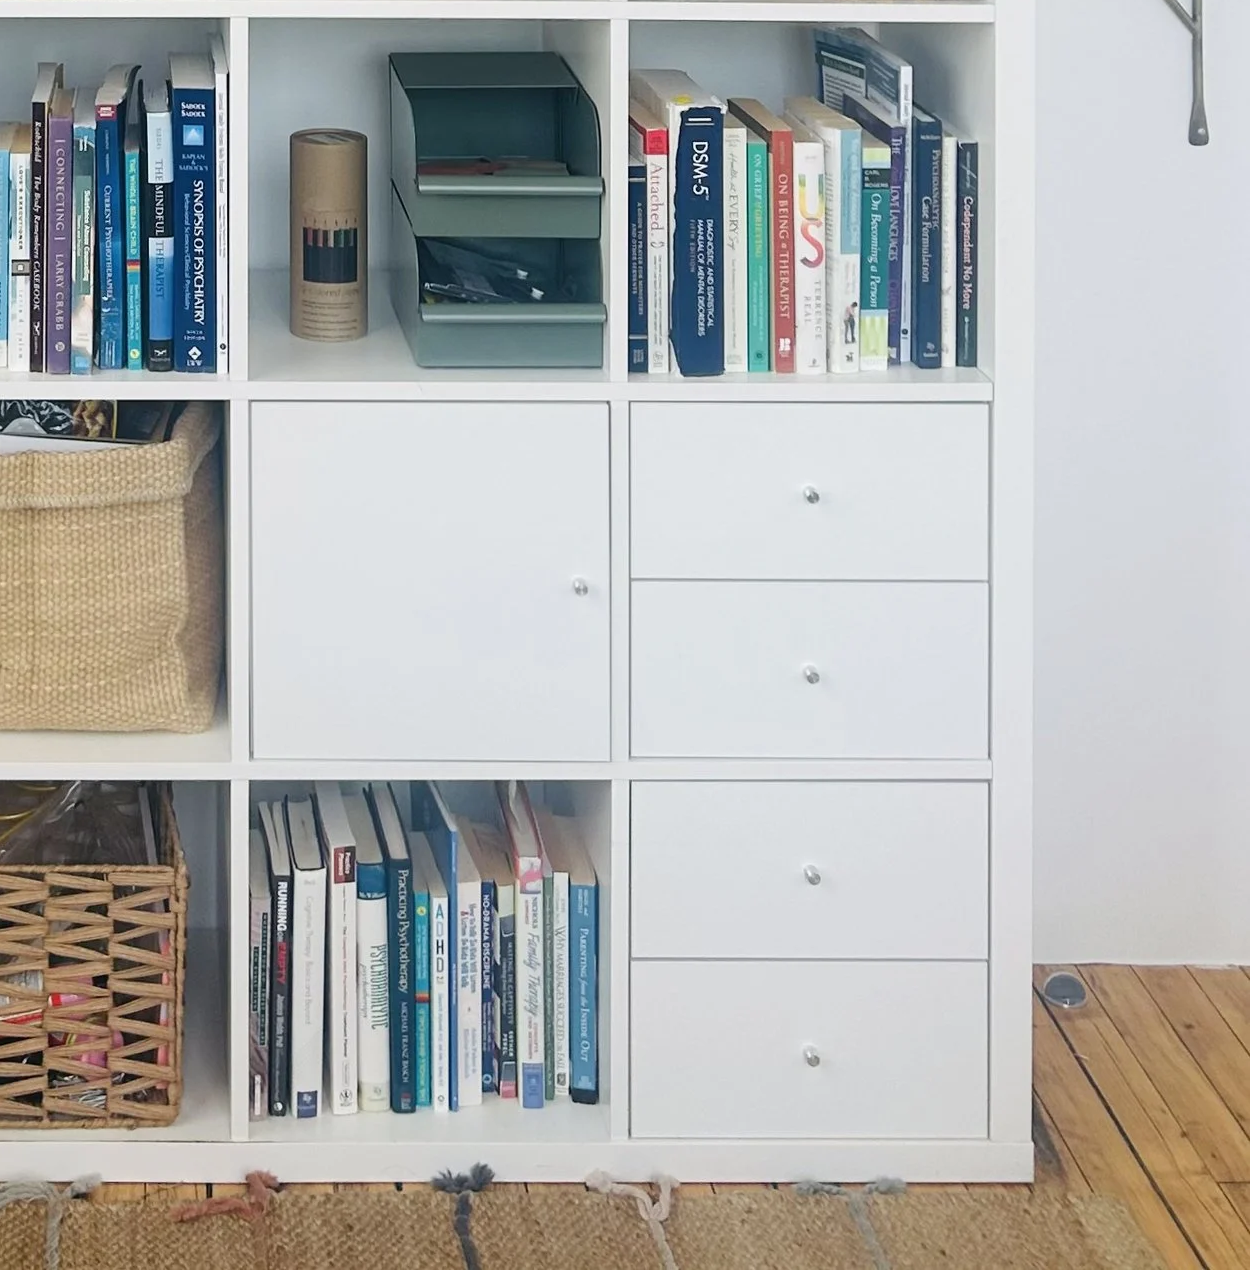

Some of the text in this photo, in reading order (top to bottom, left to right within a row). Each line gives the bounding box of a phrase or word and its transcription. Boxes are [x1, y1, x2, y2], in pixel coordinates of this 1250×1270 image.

[34, 121, 42, 163] Rothschild
[33, 192, 41, 212] Body
[56, 149, 65, 231] CONNECTING
[104, 185, 113, 225] CURRENT
[778, 174, 788, 195] ON
[870, 193, 882, 211] On
[889, 137, 903, 261] THE LOVE LANGUAGES
[932, 149, 941, 230] PSYCHOANALYTIC
[154, 159, 165, 298] THE MINDFUL THERAPIST
[192, 180, 204, 235] SYNOPSIS
[778, 200, 789, 239] BEING
[33, 215, 41, 259] Remembers
[193, 239, 204, 256] OF
[706, 219, 714, 266] DIAGNOSTIC
[868, 213, 882, 264] Becoming
[921, 196, 932, 282] Case Formulation
[961, 196, 973, 263] Codependent
[104, 227, 113, 298] PSYCHOTHERAPIES
[697, 253, 705, 263] OF
[697, 266, 705, 293] MENTAL
[963, 266, 973, 280] No
[55, 254, 65, 330] LARRY CRABB
[193, 257, 205, 326] PSYCHIATRY
[779, 251, 790, 319] THERAPIST
[870, 274, 883, 307] Person
[962, 283, 972, 310] More
[697, 295, 705, 336] DISORDERS
[814, 280, 822, 340] TERRENCE
[277, 882, 288, 931] RUNNING
[396, 869, 411, 993] Practicing Psychotherapy
[555, 925, 566, 951] WHY
[580, 928, 589, 977] PARENTING
[277, 942, 287, 984] EMPTY
[523, 932, 540, 1017] Family Therapy
[556, 953, 565, 1001] MARRIAGES
[370, 943, 388, 1030] PSYCHOANALYTIC
[400, 1001, 408, 1032] MICHAEL
[556, 1002, 566, 1041] SUCCEED
[580, 1008, 589, 1038] INSIDE
[401, 1060, 409, 1083] BASCH
[557, 1053, 565, 1070] FAIL
[580, 1040, 590, 1062] OUT
